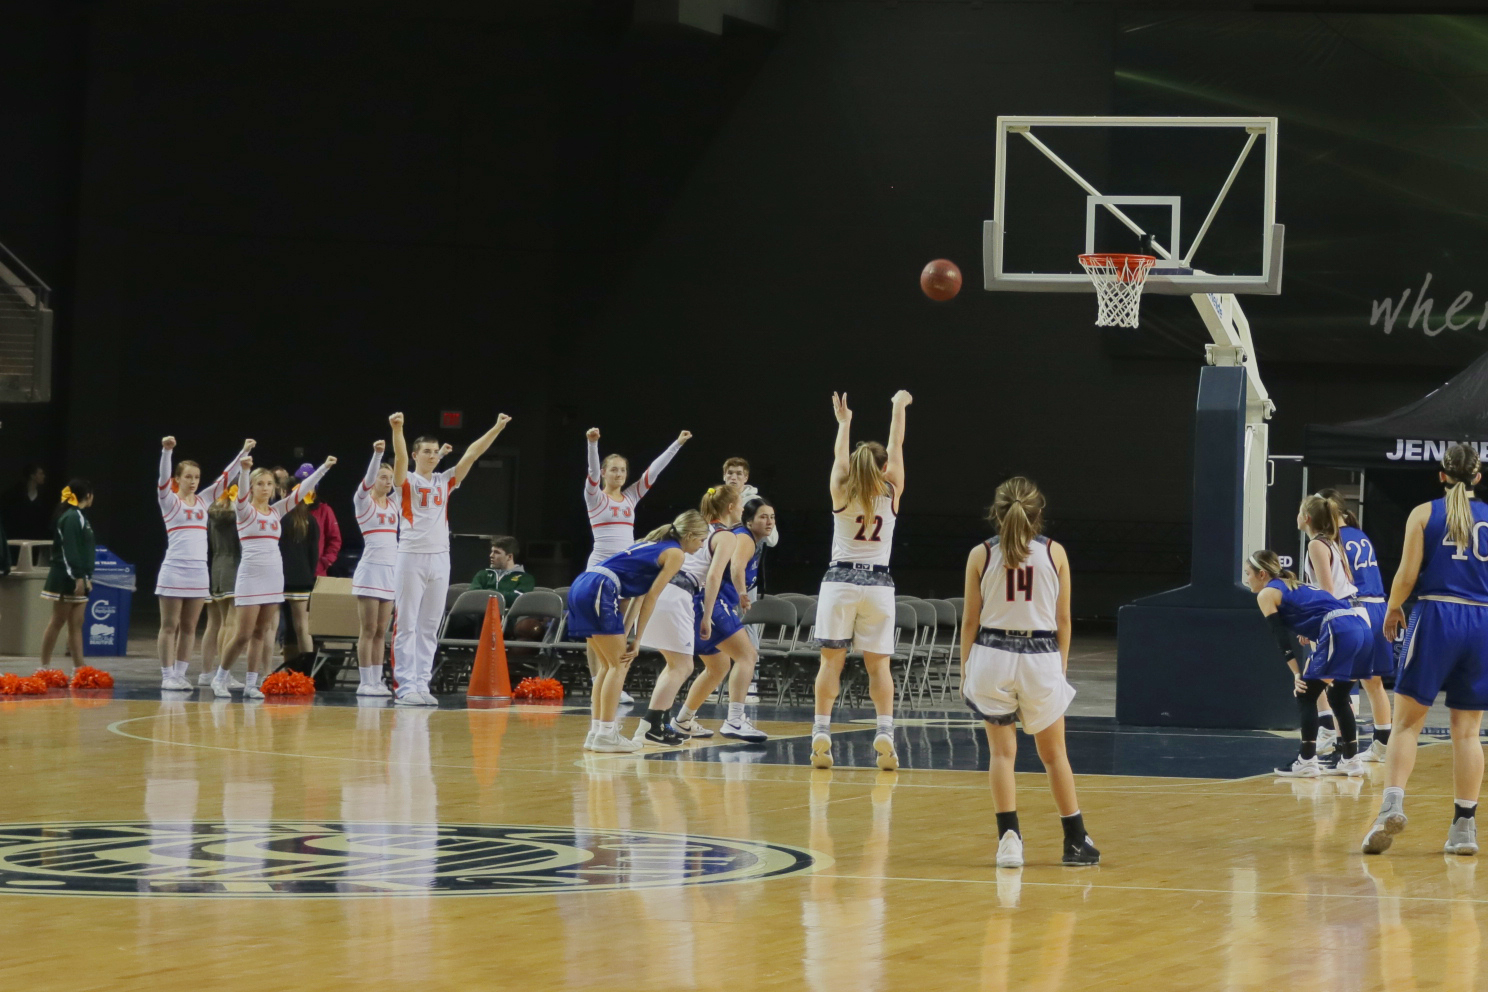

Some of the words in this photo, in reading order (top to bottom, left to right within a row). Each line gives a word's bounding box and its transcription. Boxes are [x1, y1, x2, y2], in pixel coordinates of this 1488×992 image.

[854, 515, 883, 542] 22
[1345, 539, 1378, 571] 22
[1005, 566, 1033, 602] 14
